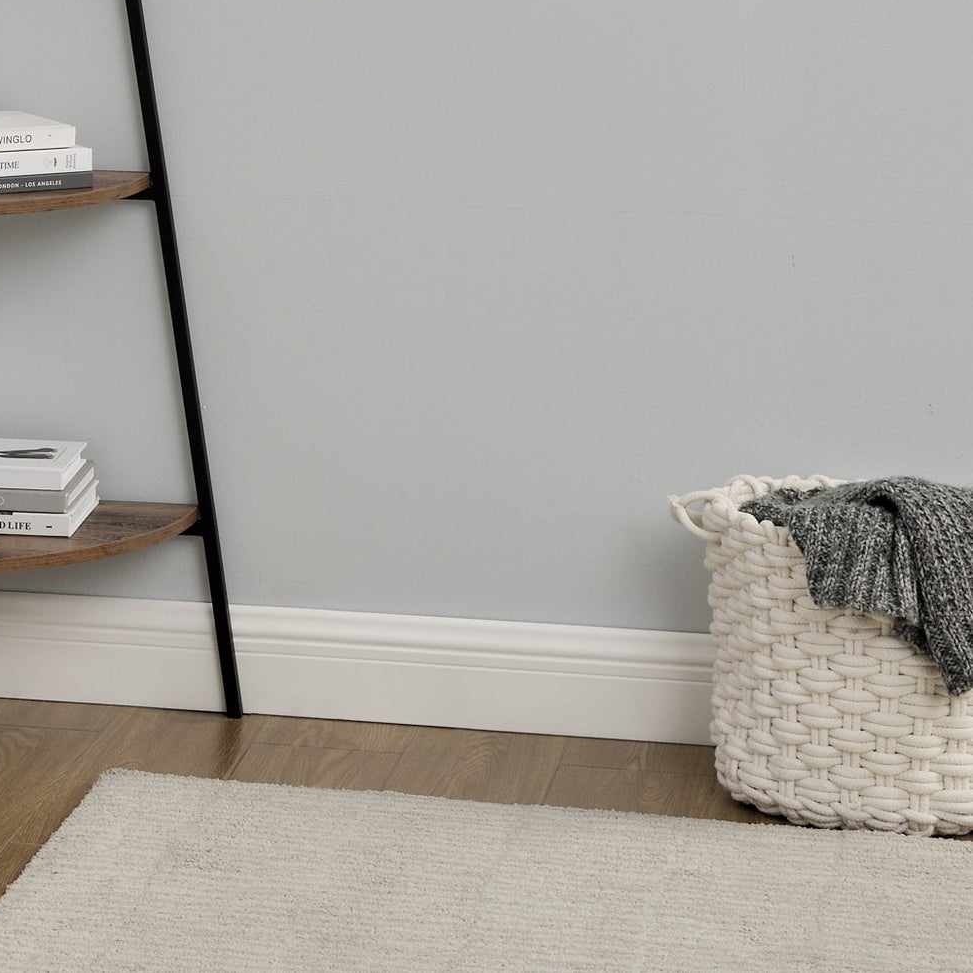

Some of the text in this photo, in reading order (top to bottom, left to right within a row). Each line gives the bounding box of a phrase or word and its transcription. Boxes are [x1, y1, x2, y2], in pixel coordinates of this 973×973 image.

[0, 161, 20, 170] TIME
[37, 179, 62, 187] ANGELES
[8, 521, 32, 530] LIFE
